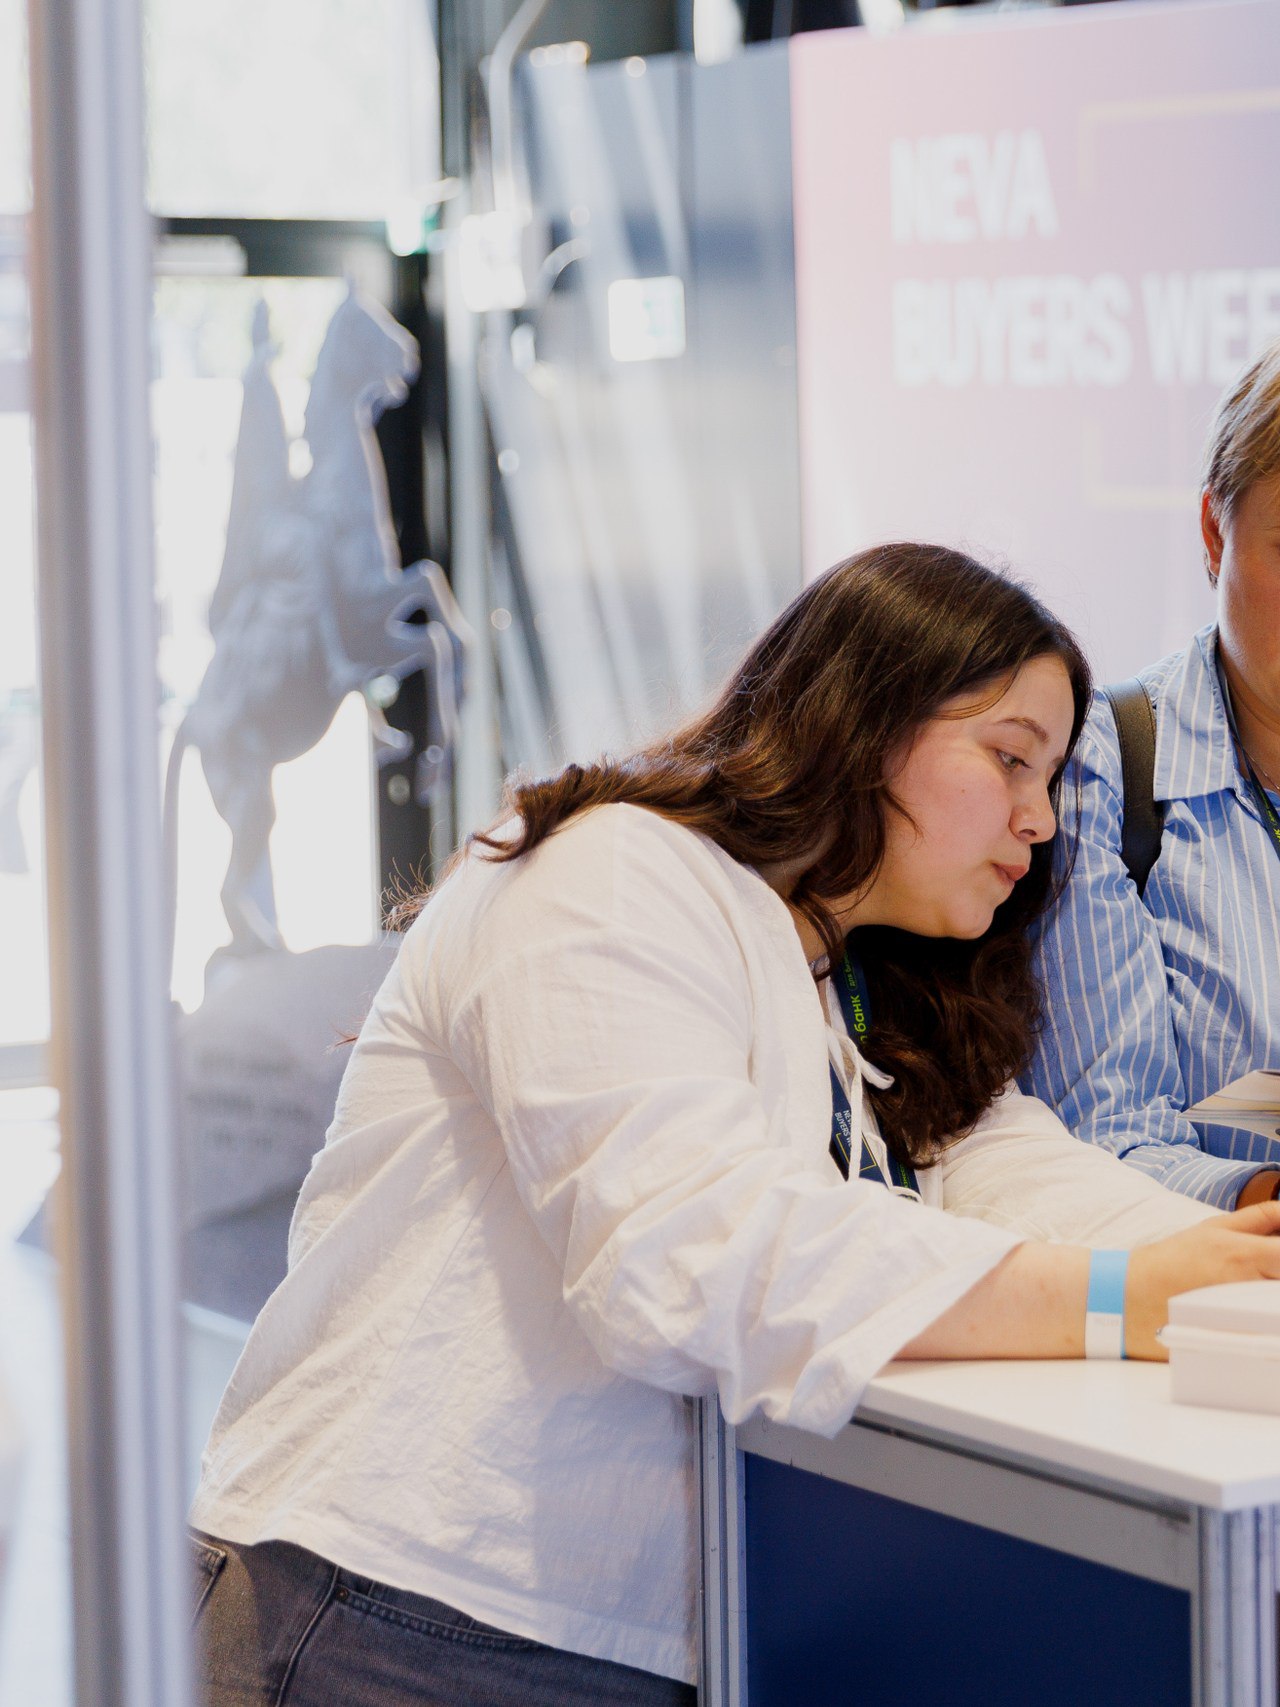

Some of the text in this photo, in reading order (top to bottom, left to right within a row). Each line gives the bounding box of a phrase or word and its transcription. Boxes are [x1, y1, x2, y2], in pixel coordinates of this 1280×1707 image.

[891, 129, 1059, 243] NEVA
[893, 273, 1133, 388] BUYERS
[850, 994, 867, 1033] банк
[834, 1111, 850, 1137] BUYERS
